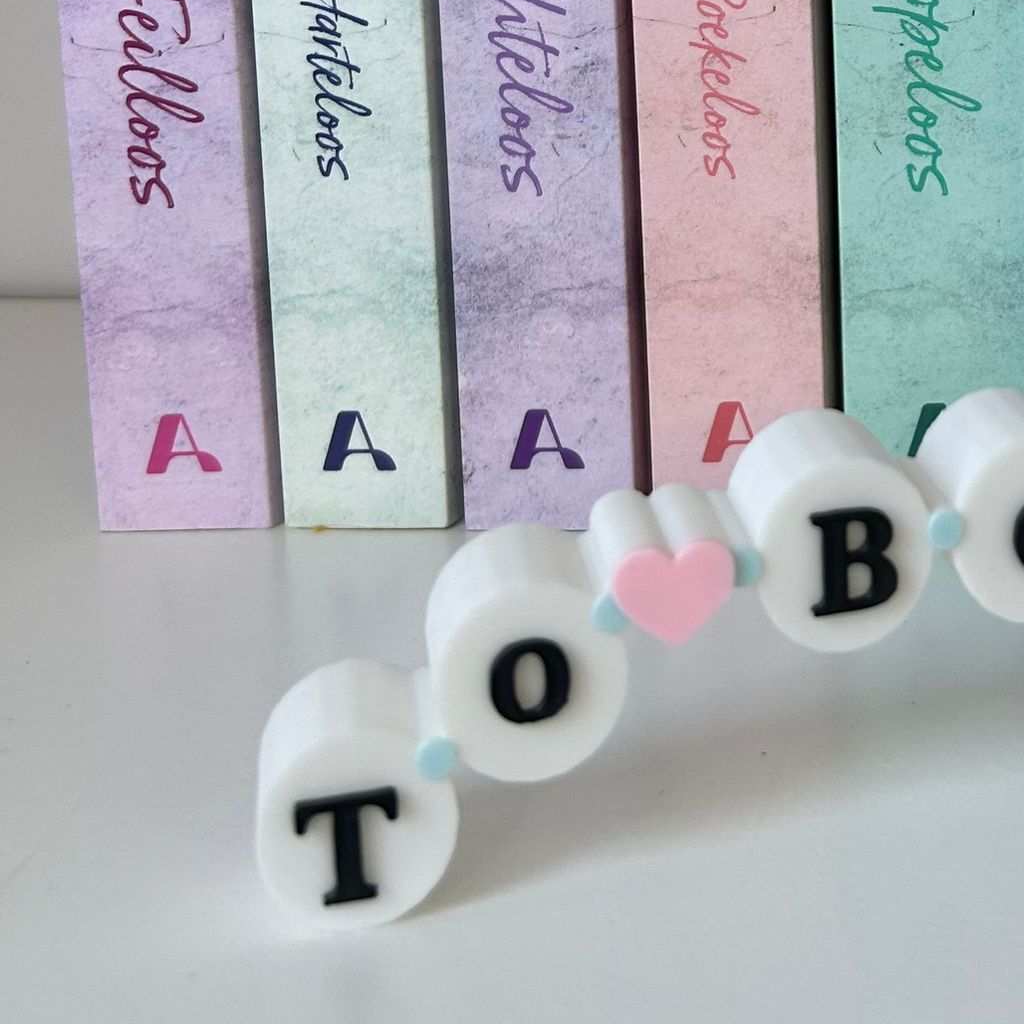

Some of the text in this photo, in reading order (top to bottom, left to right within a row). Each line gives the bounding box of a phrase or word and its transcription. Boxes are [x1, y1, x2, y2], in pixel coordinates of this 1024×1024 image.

[147, 413, 223, 474] A
[322, 410, 397, 472] A
[510, 408, 585, 470] A
